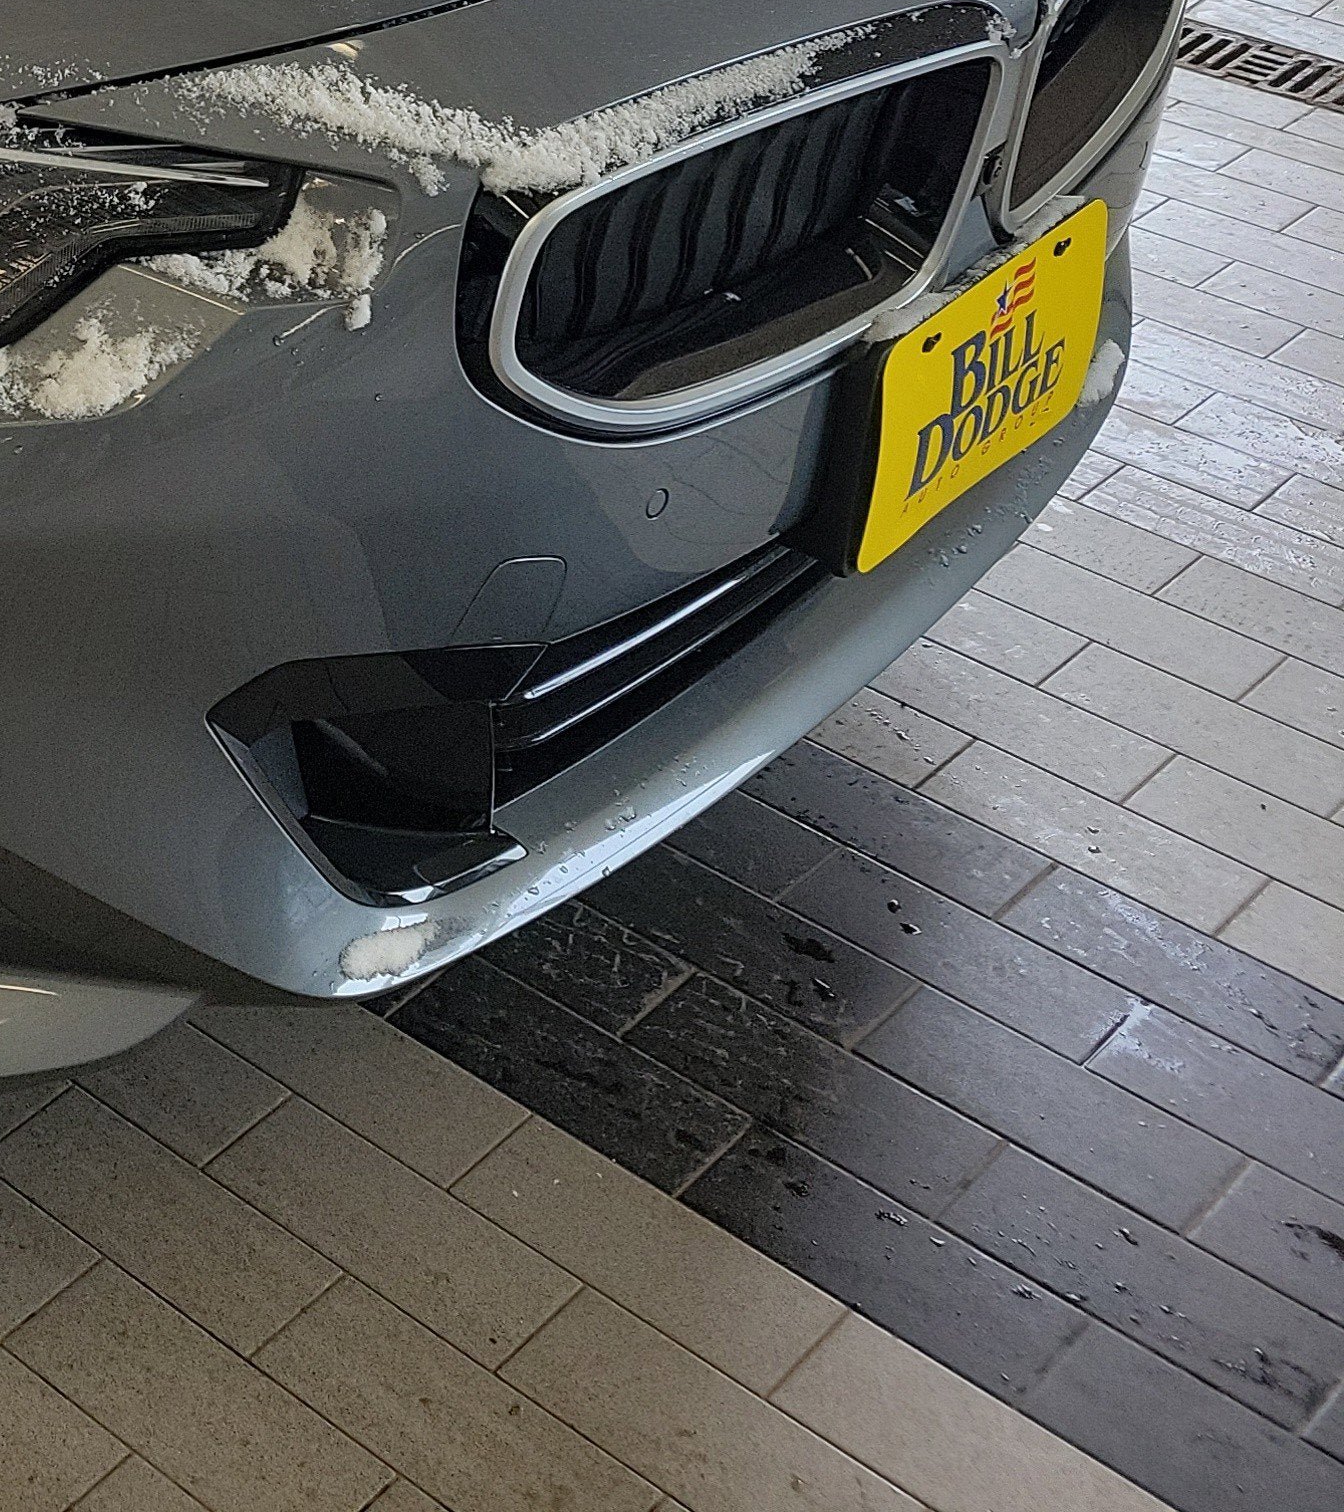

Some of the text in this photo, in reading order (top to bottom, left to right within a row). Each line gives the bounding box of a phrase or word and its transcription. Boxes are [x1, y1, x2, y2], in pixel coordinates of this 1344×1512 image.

[903, 337, 1066, 503] DODGE
[951, 308, 1046, 415] BILL
[899, 390, 1055, 519] AUTO GROUP
